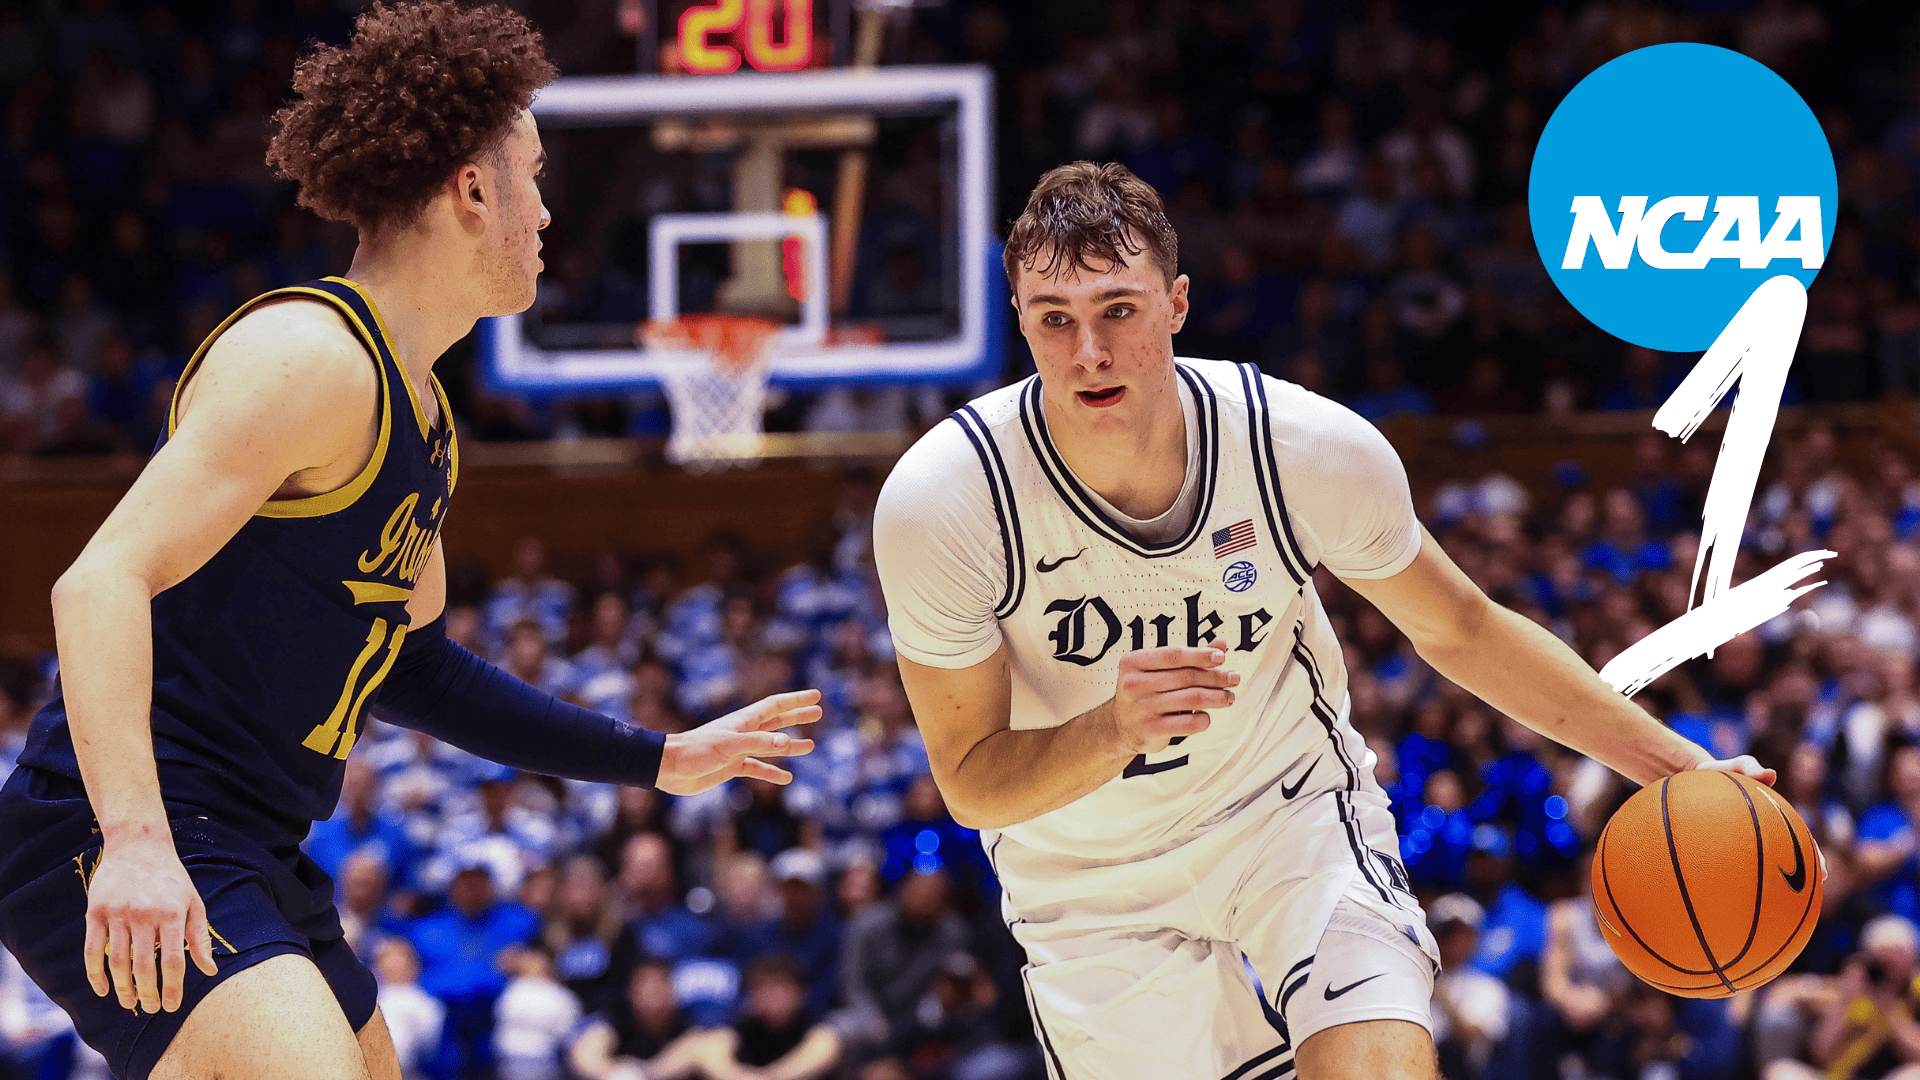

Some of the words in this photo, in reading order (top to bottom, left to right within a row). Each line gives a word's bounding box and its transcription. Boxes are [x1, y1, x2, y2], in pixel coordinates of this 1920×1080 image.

[677, 0, 813, 74] 20
[357, 492, 448, 584] Iris
[1042, 590, 1274, 667] Duke
[301, 616, 408, 761] 11
